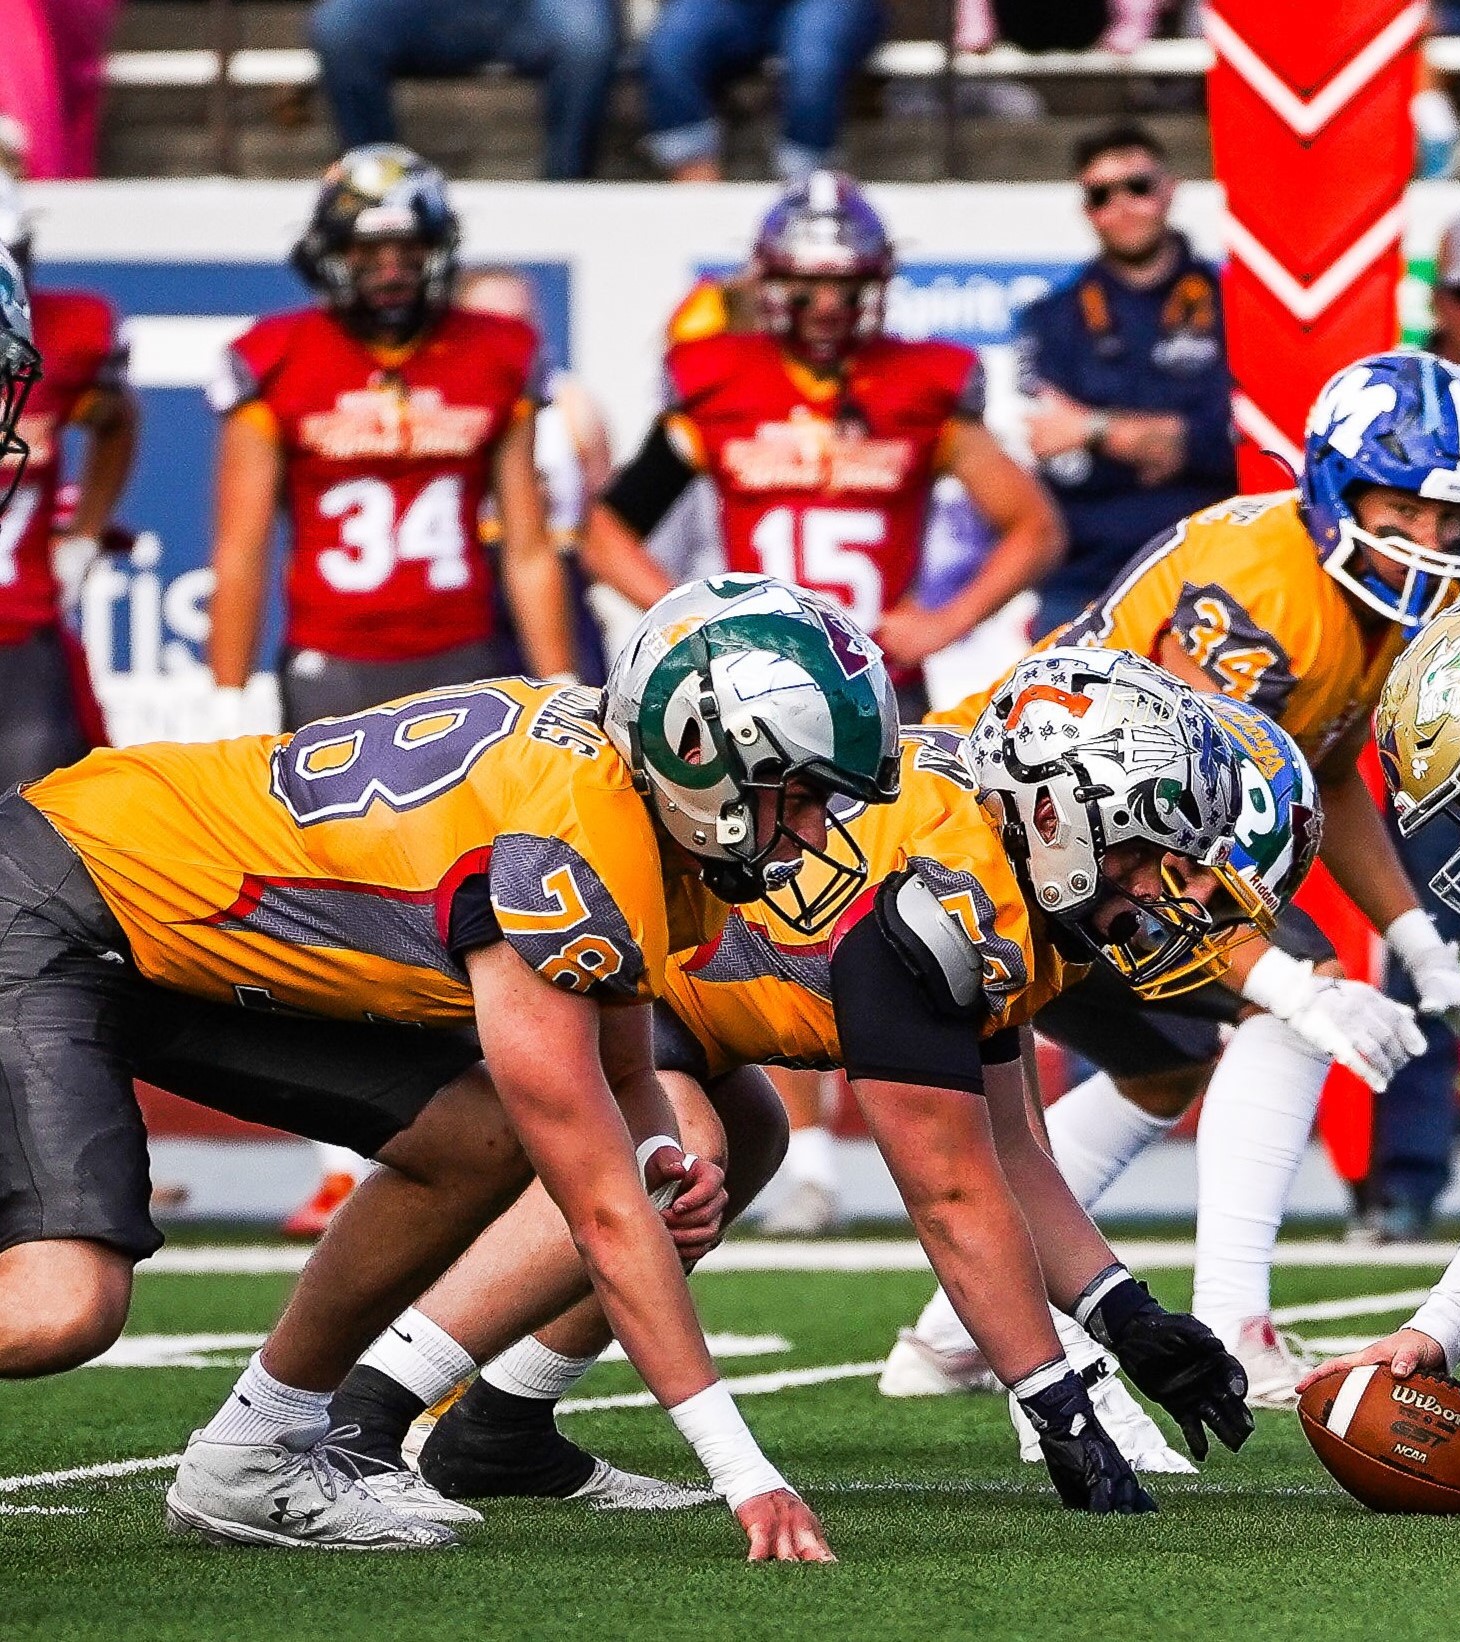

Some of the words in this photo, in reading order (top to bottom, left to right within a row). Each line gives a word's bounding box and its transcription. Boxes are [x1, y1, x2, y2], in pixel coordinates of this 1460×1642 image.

[317, 476, 472, 593] 34
[751, 505, 888, 636] 15
[1189, 597, 1279, 704] 34
[268, 676, 530, 829] 8
[491, 864, 625, 995] 78
[1393, 1442, 1428, 1464] NCAA
